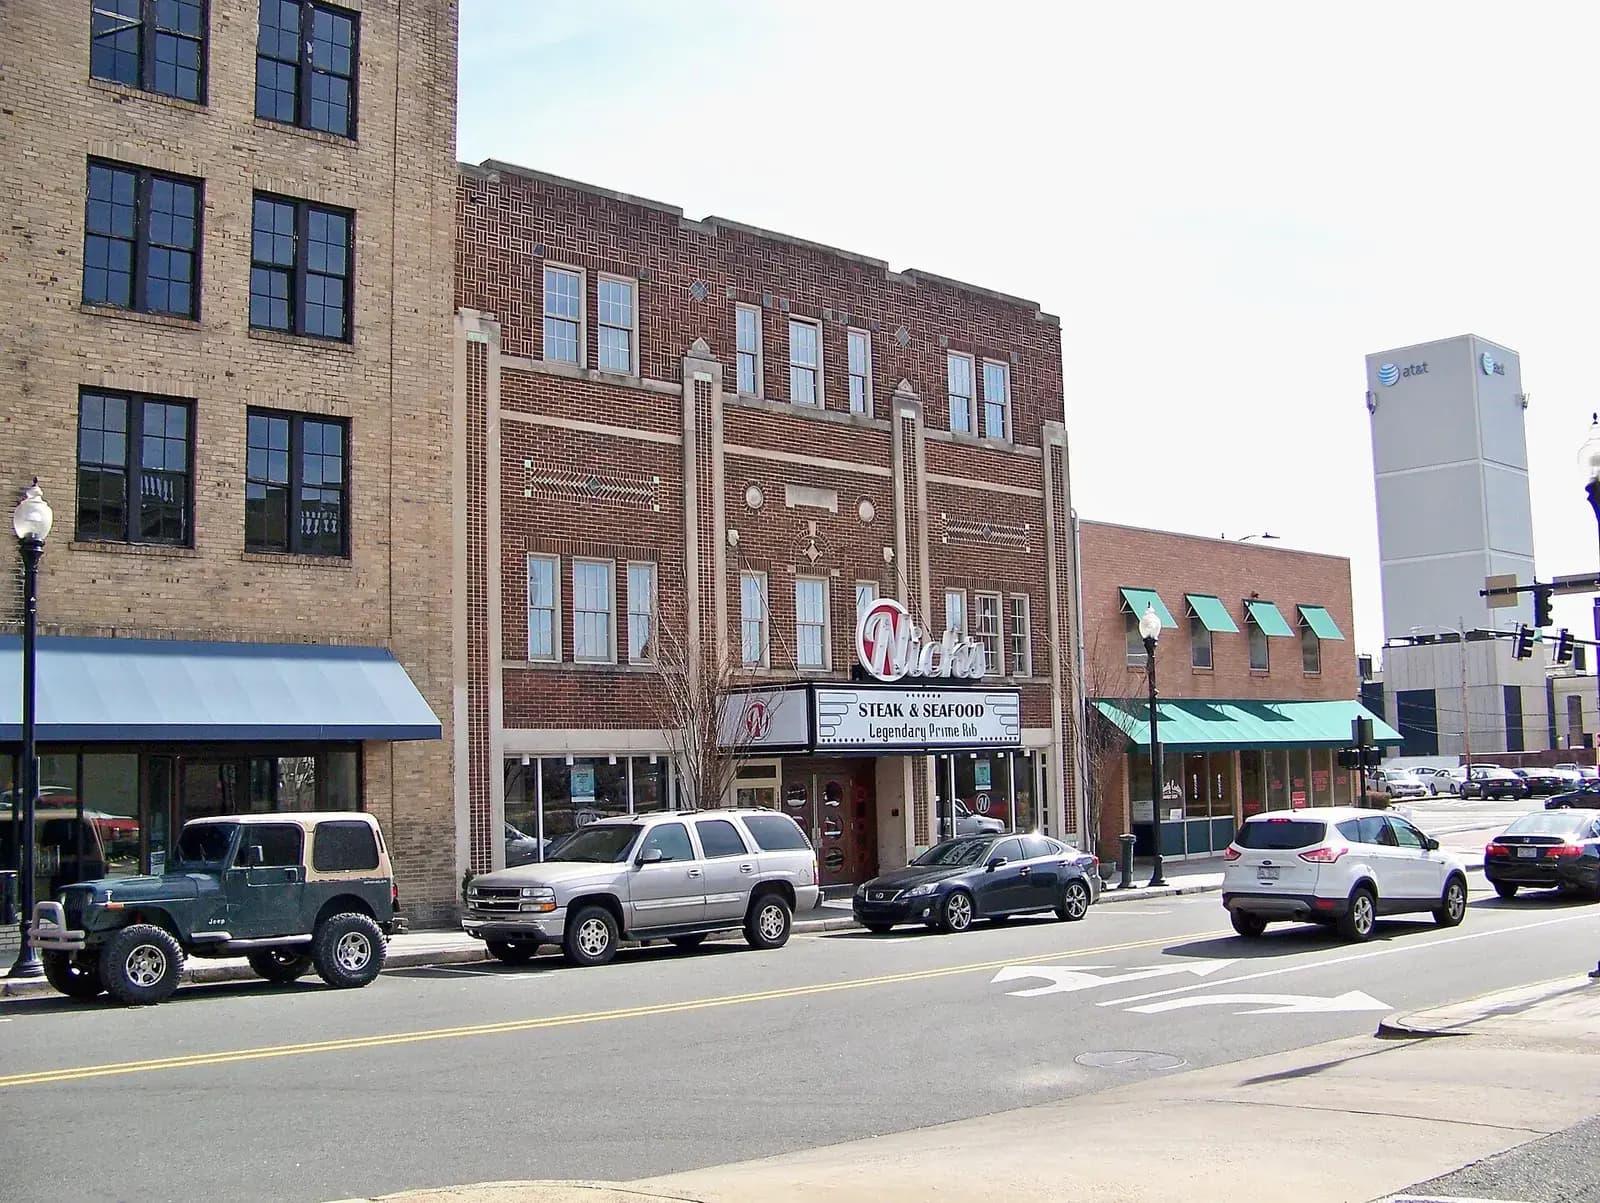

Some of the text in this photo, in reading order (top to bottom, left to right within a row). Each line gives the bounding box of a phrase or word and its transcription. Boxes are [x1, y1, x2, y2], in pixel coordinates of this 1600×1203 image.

[858, 703, 984, 718] STEAK & SEAFOOD
[869, 723, 978, 741] Legendary Prime Rib
